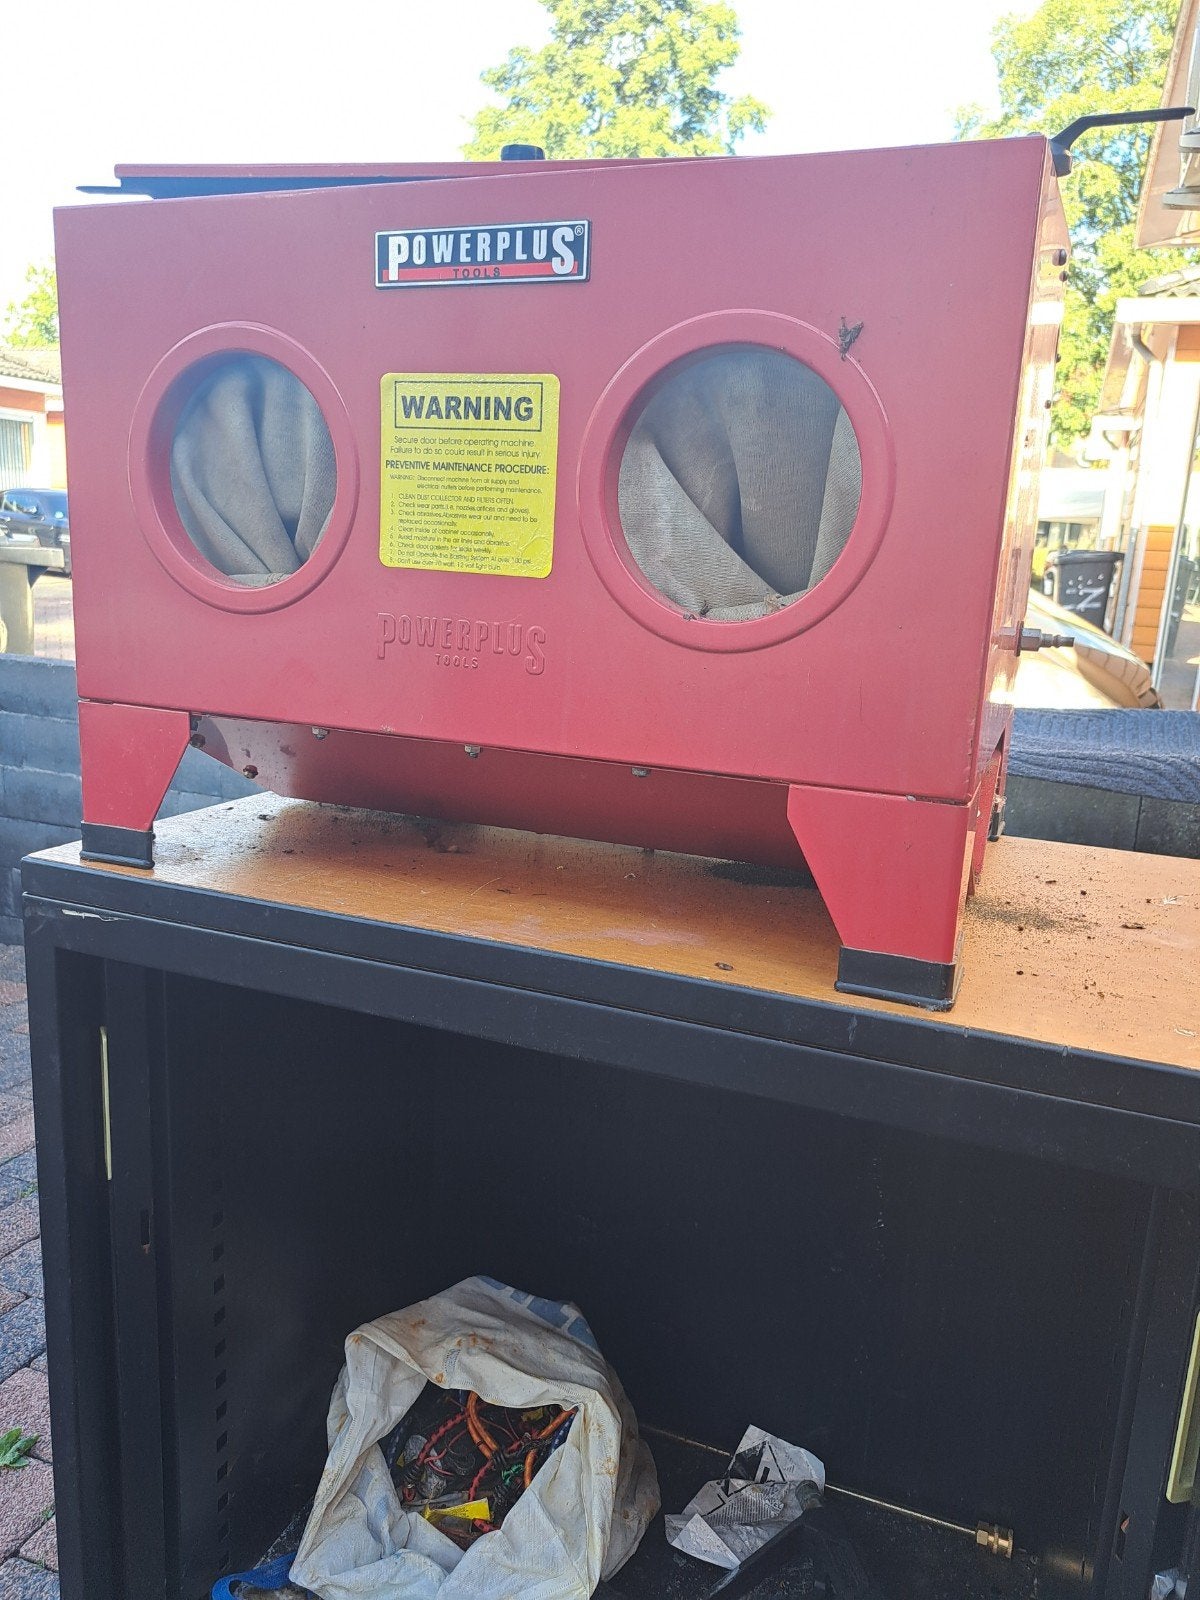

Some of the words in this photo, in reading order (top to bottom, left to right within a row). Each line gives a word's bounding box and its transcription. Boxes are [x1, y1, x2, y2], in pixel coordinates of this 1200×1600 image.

[452, 267, 501, 279] TOOLS
[401, 395, 534, 421] WARNING
[394, 435, 419, 445] Secure
[420, 436, 437, 446] door
[438, 437, 463, 446] before
[463, 438, 499, 449] operating
[390, 445, 413, 454] Failure
[414, 446, 422, 455] to
[423, 447, 433, 455] do
[445, 448, 465, 456] could
[467, 448, 485, 457] result
[487, 449, 494, 457] in
[495, 450, 519, 458] serious
[385, 460, 431, 470] PREVENTIVE
[432, 461, 493, 472] MAINTENANCE
[494, 463, 550, 475] PROCEDURE:
[491, 478, 507, 486] supply
[476, 486, 504, 494] performing
[377, 612, 546, 676] POWERPLUS
[435, 653, 479, 669] TOOLS
